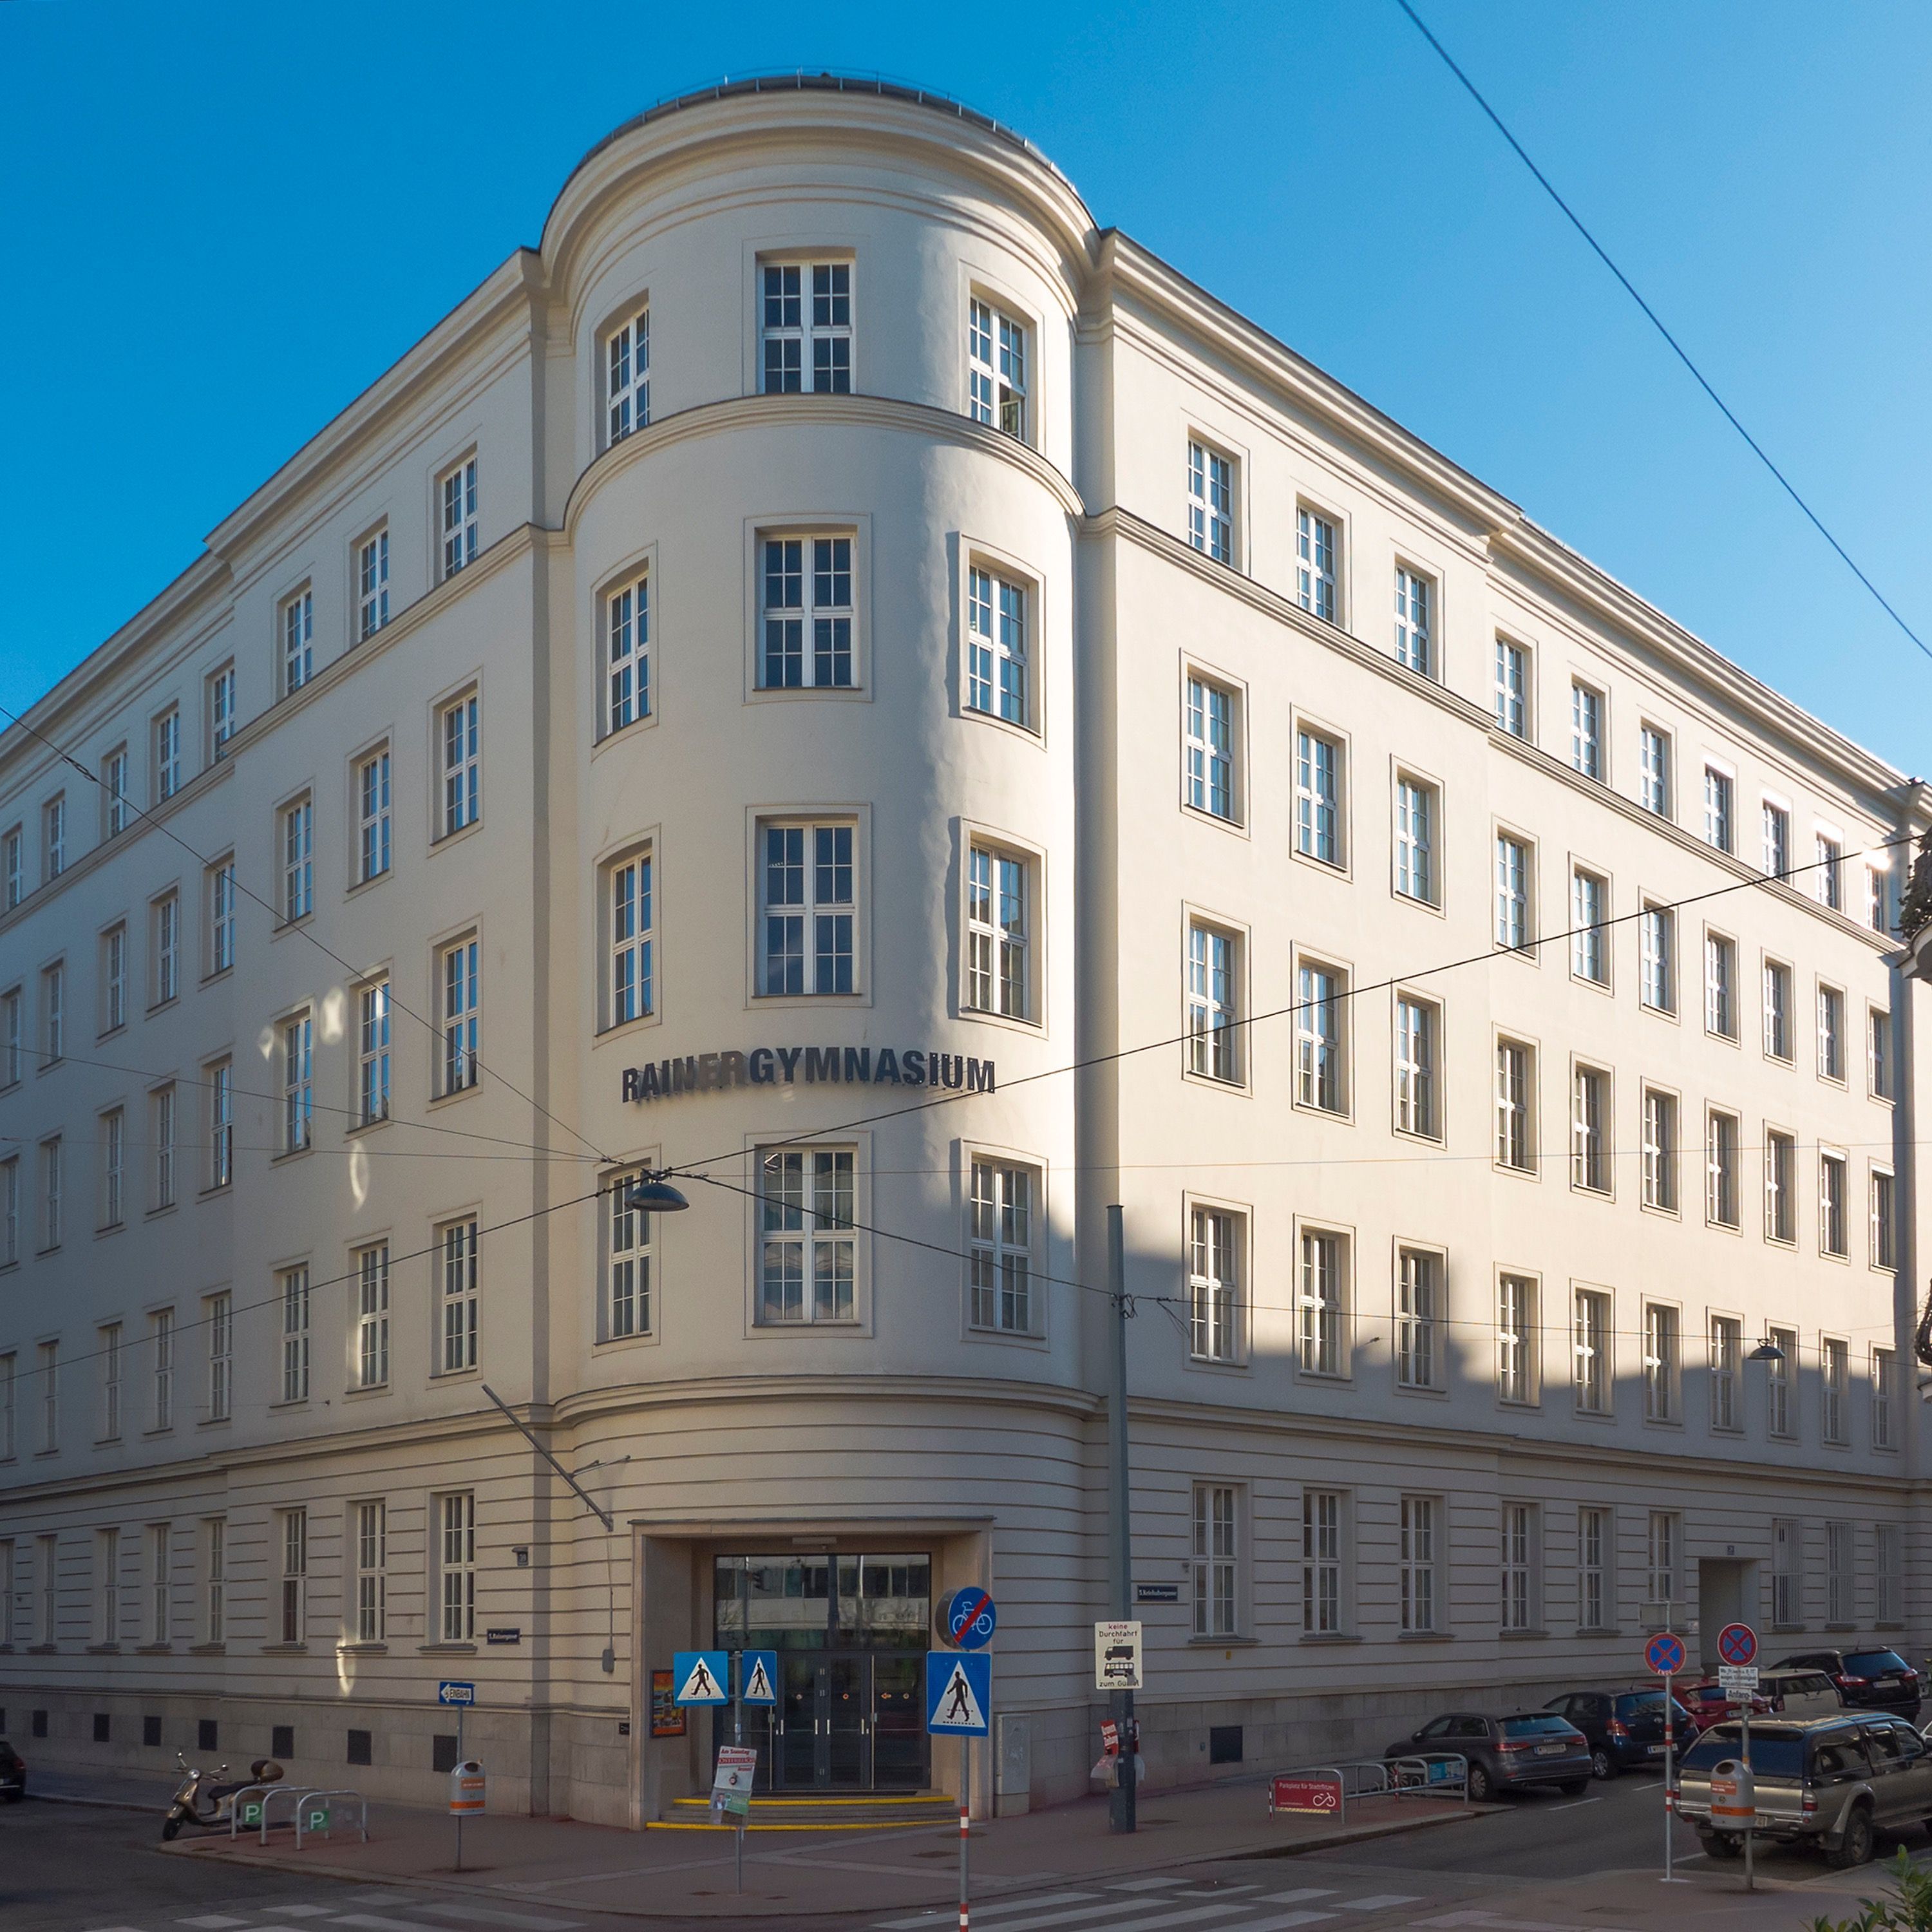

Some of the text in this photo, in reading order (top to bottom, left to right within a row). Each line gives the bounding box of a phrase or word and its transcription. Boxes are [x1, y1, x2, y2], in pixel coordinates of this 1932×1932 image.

[622, 1047, 996, 1103] RAINERGYMNASIUM
[450, 1689, 469, 1698] EINBAHN
[245, 1805, 260, 1822] P
[310, 1812, 325, 1830] P
